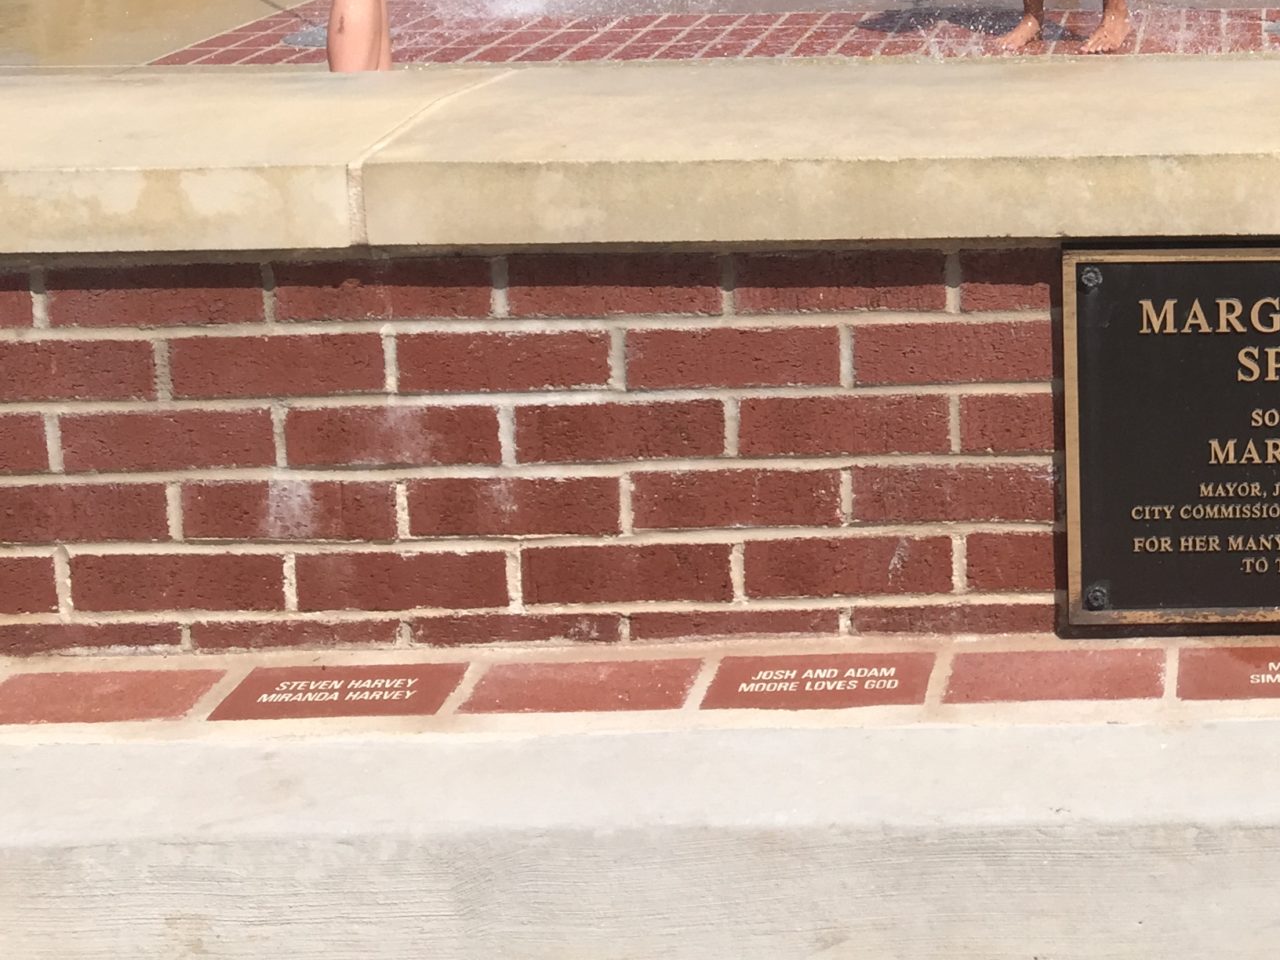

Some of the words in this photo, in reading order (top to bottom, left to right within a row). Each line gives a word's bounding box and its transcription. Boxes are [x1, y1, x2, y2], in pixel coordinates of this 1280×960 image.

[1251, 408, 1280, 427] SO
[1199, 482, 1267, 498] MAYOR,
[1131, 505, 1175, 520] CITY
[1133, 535, 1173, 552] FOR
[1180, 535, 1221, 552] HER
[1242, 556, 1269, 573] TO
[752, 670, 797, 680] JOSH
[801, 668, 838, 678] AND
[844, 667, 896, 678] ADAM
[275, 680, 344, 691] STEVEN
[347, 678, 419, 688] HARVEY
[738, 681, 799, 692] MOORE
[805, 680, 858, 691] LOVES
[864, 679, 899, 689] GOD
[257, 691, 340, 703] MIRANDA
[344, 690, 418, 701] HARVEY
